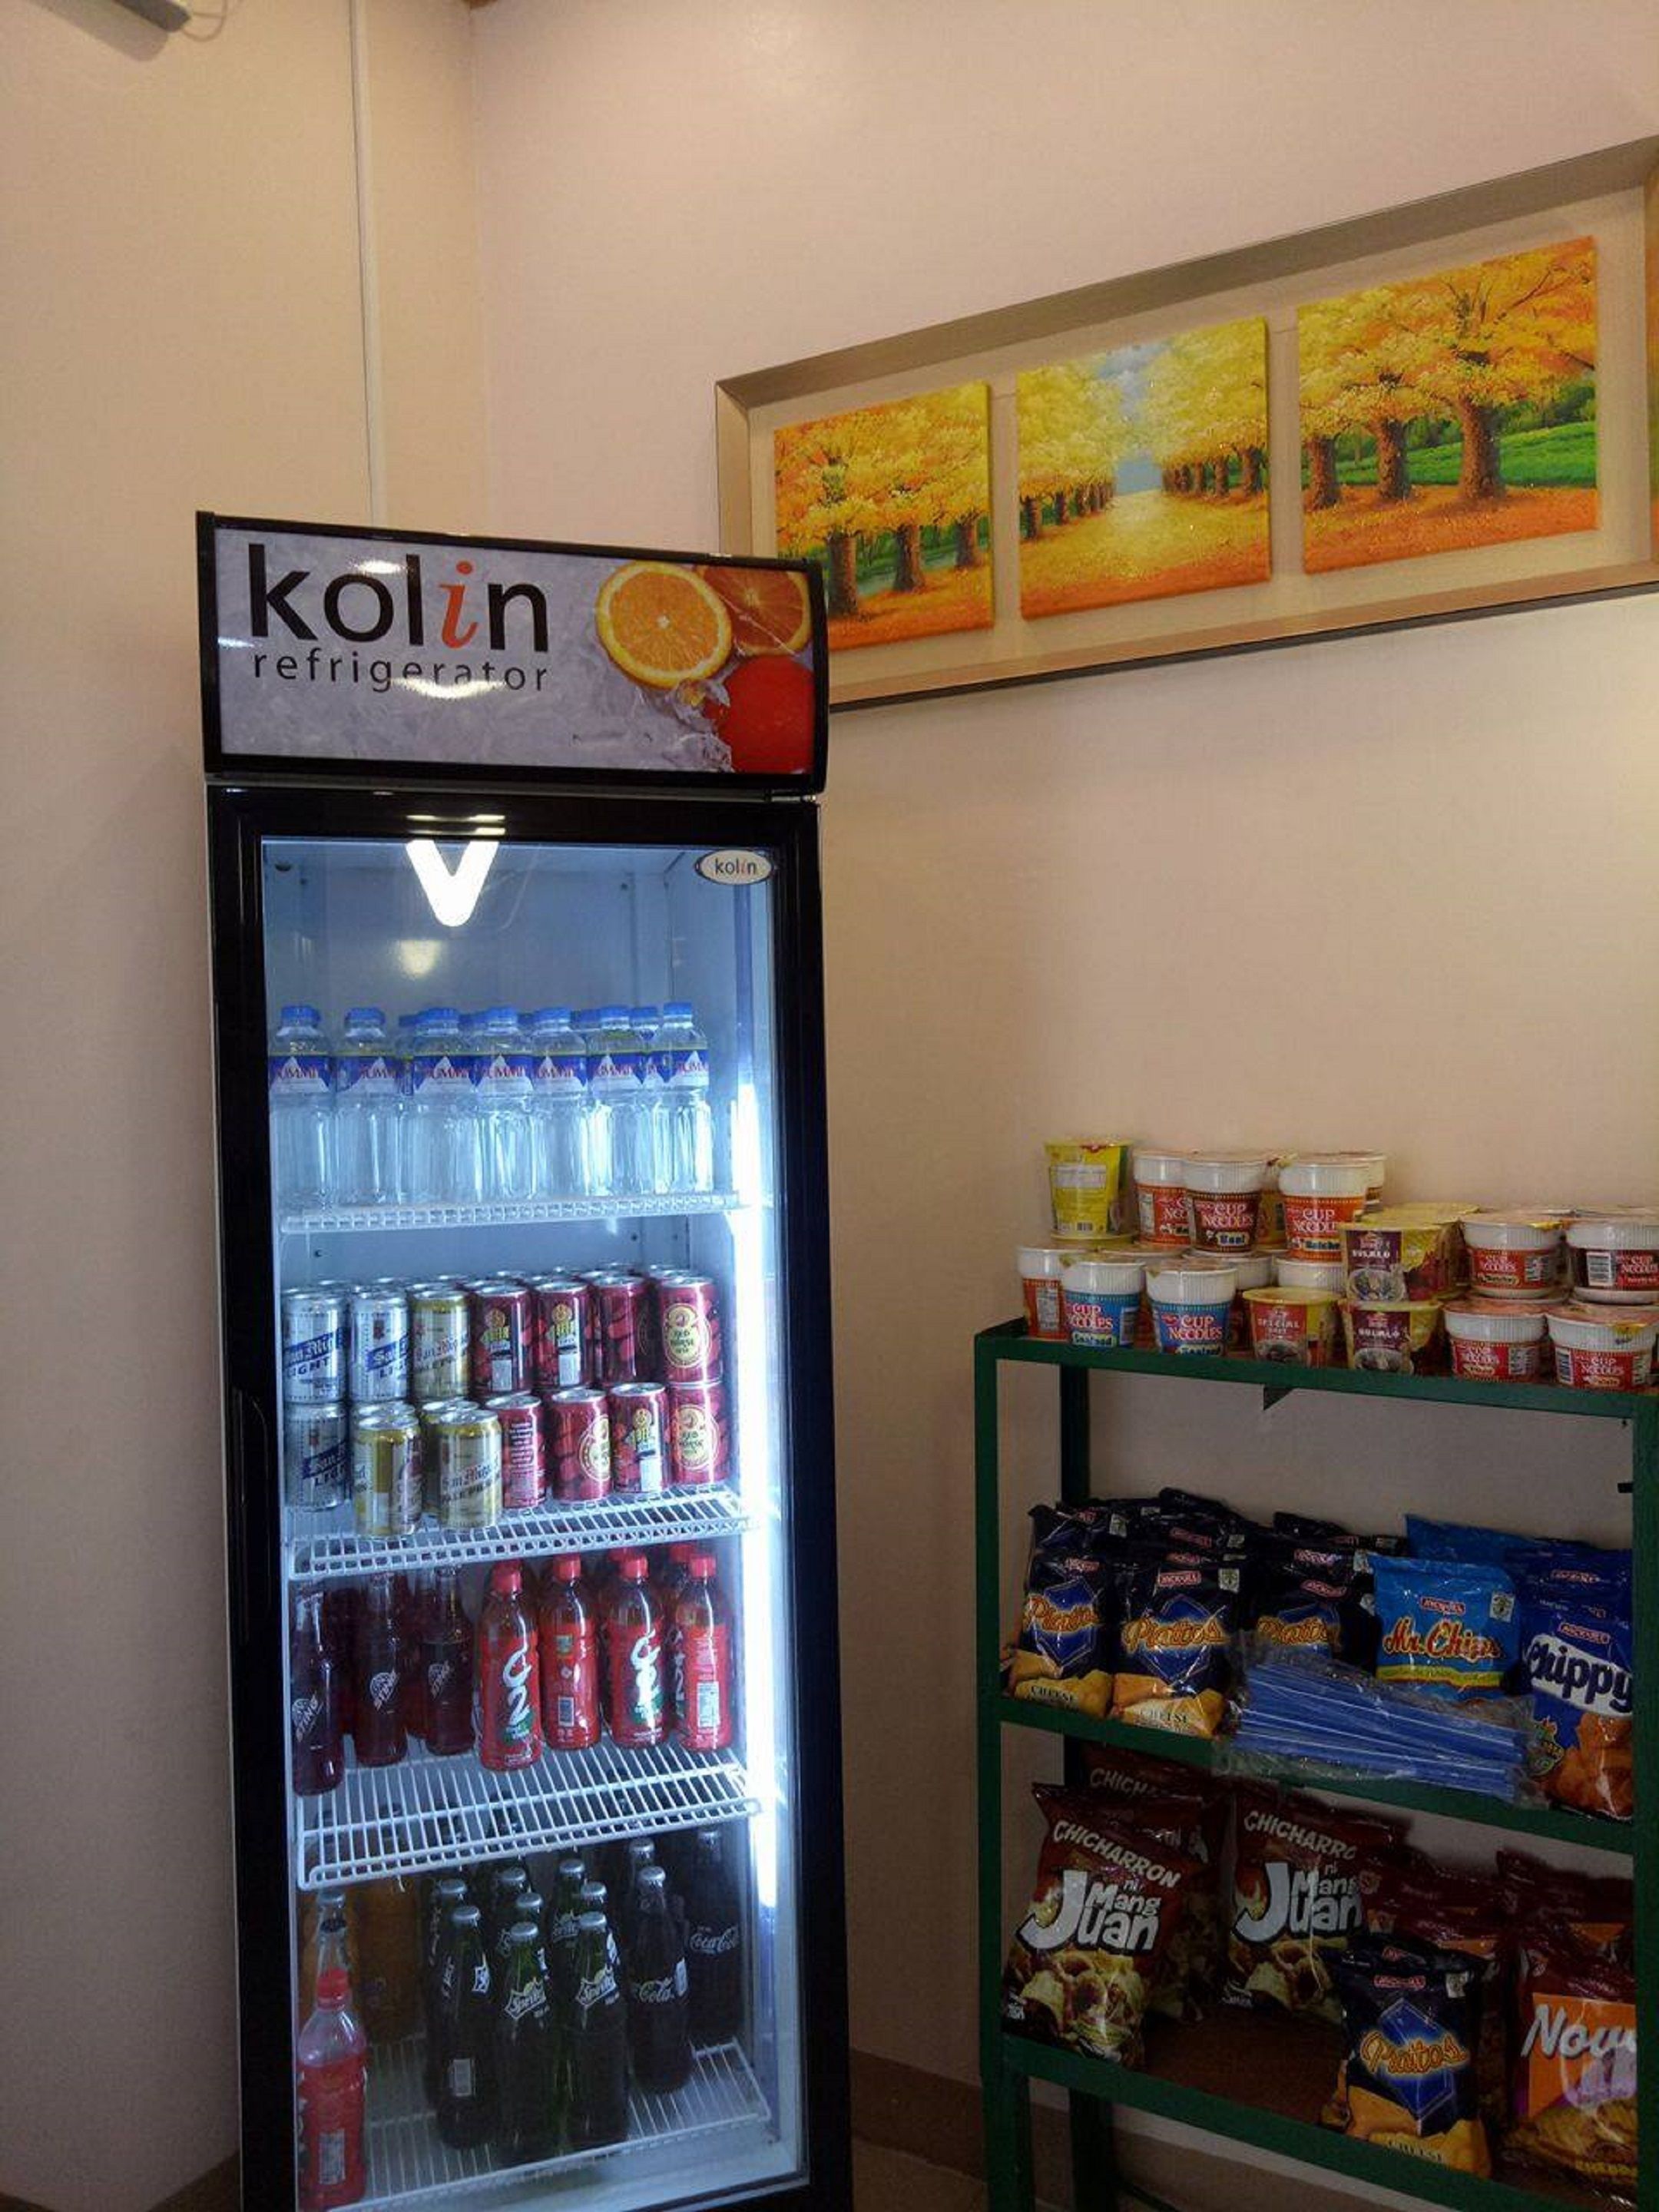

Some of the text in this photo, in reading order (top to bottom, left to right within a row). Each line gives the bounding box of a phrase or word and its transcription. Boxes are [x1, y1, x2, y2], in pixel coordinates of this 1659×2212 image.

[247, 542, 550, 653] kolin
[253, 649, 549, 693] refrigerator
[714, 856, 758, 877] kolin
[1089, 1768, 1149, 1795] CHICH
[1053, 1820, 1181, 1888] CHICHARRON
[1243, 1810, 1358, 1861] CHICHARRO
[1018, 1869, 1161, 1951] Juan
[1085, 1882, 1162, 1916] Mang
[1235, 1862, 1363, 1942] Juan
